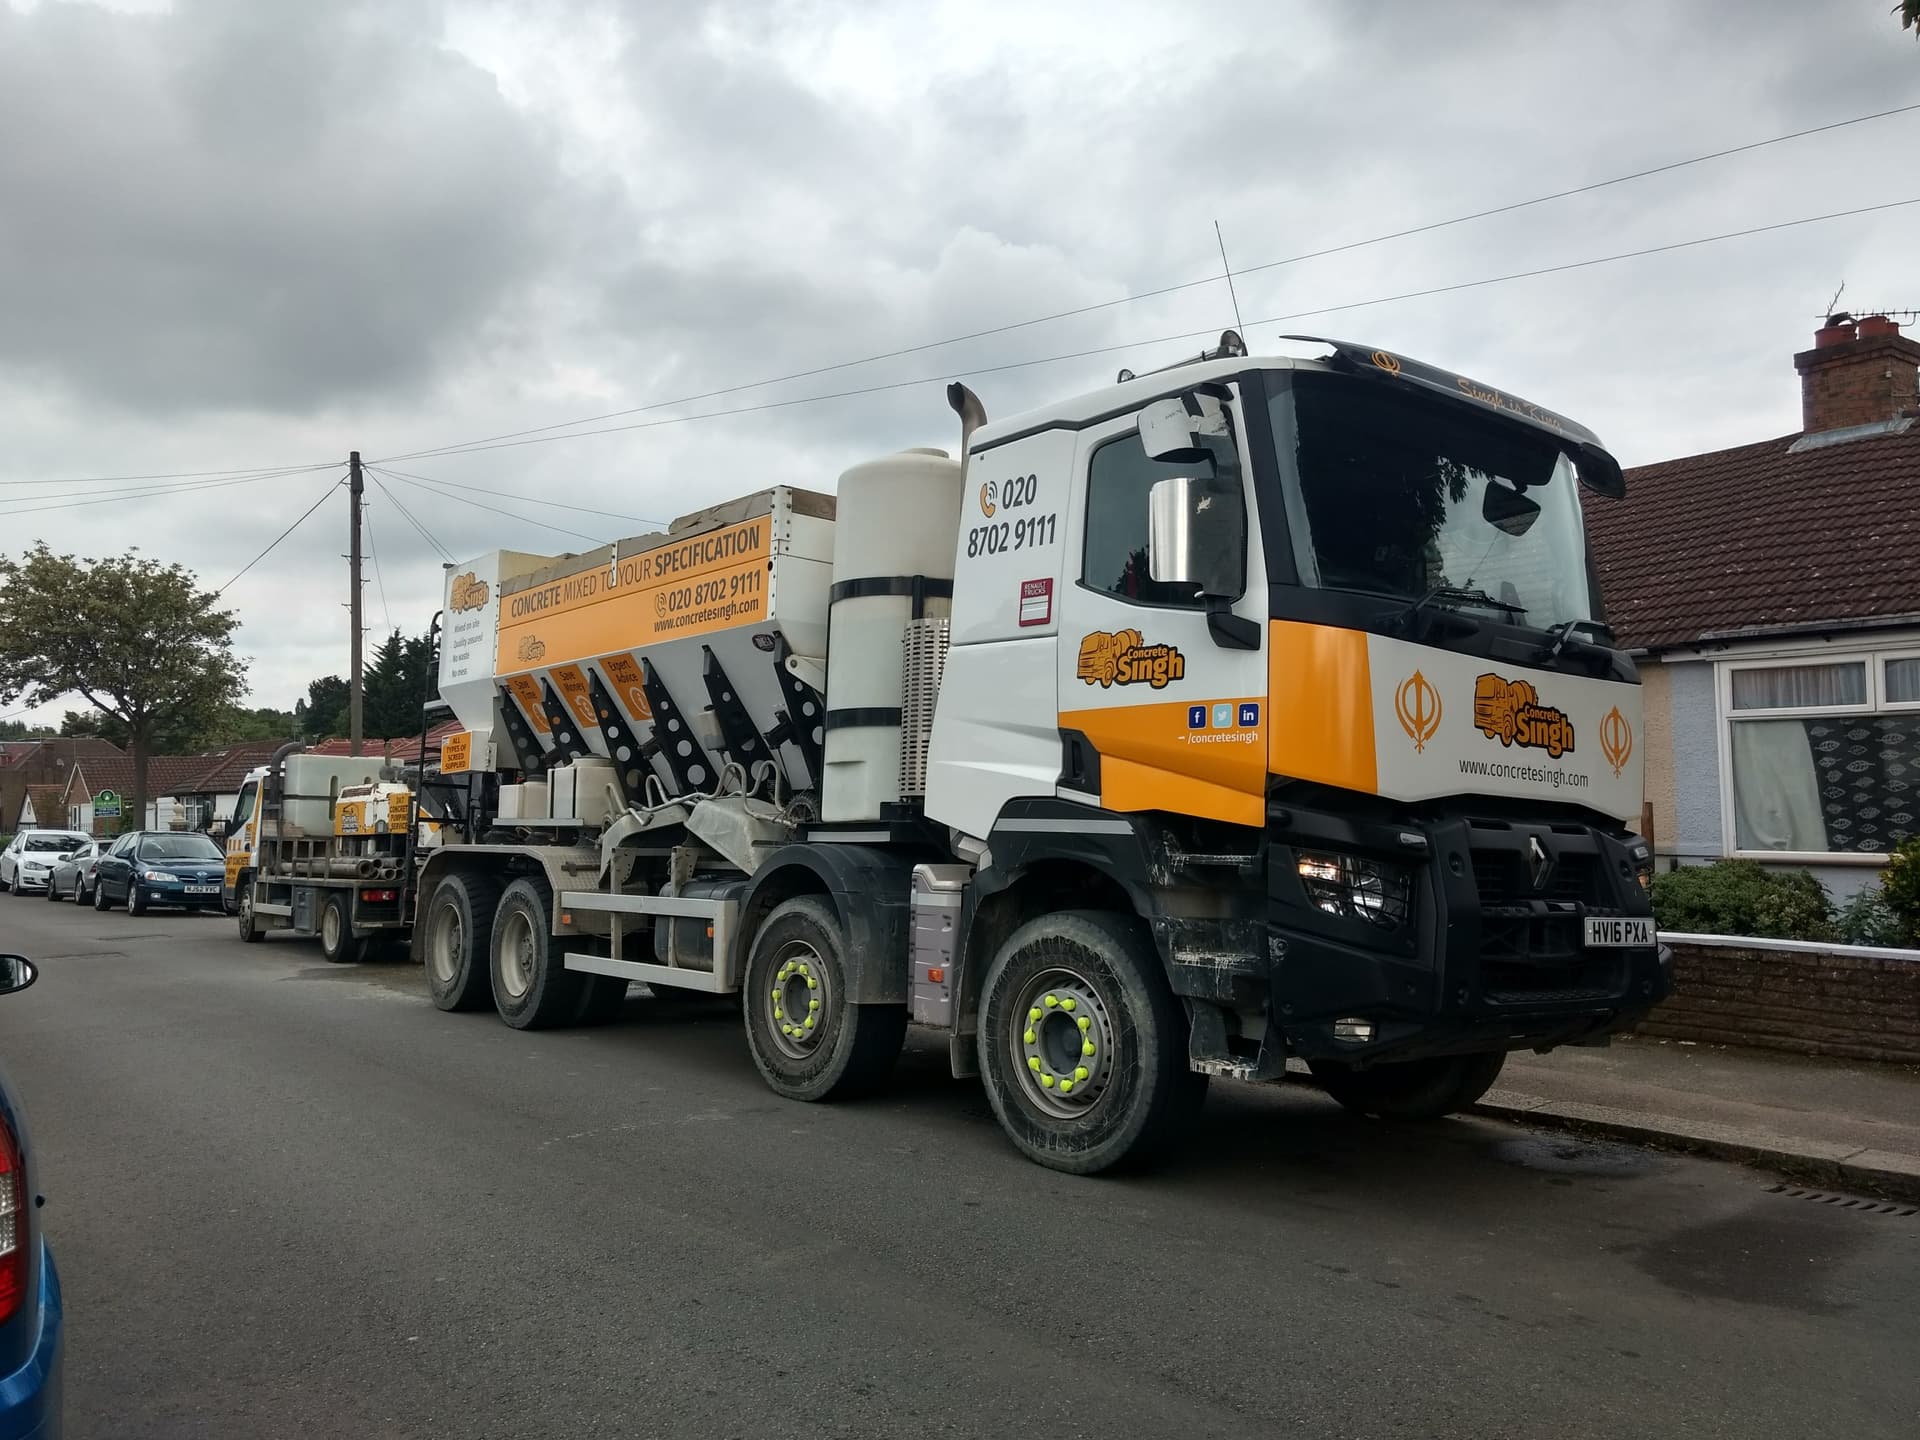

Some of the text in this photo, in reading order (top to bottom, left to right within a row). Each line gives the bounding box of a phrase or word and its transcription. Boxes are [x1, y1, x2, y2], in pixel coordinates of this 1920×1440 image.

[1457, 378, 1504, 410] Singh
[1002, 474, 1037, 509] 020
[967, 513, 1056, 558] 8702 9111
[511, 525, 760, 618] CONCRETE MIXED TO YOUR SPECIFICATION
[668, 569, 761, 612] 020 8702 9111
[1024, 581, 1046, 590] RENAULT
[1024, 588, 1046, 596] TRUCKS
[654, 598, 759, 632] www.concretesingh.com
[1127, 647, 1167, 659] Concrete
[607, 659, 632, 672] Expert
[1117, 651, 1183, 686] Singh
[559, 671, 576, 681] Save
[616, 672, 639, 684] Advice
[564, 682, 586, 693] Money
[1525, 705, 1560, 722] Concrete
[1516, 711, 1573, 756] Singh
[446, 743, 467, 753] TYPES OF
[447, 752, 465, 761] SCREED
[445, 760, 466, 770] SUPPLIED
[1459, 759, 1589, 788] www.concretesingh.com
[389, 805, 408, 813] CONCRET
[1592, 921, 1648, 943] HV16 PXA
